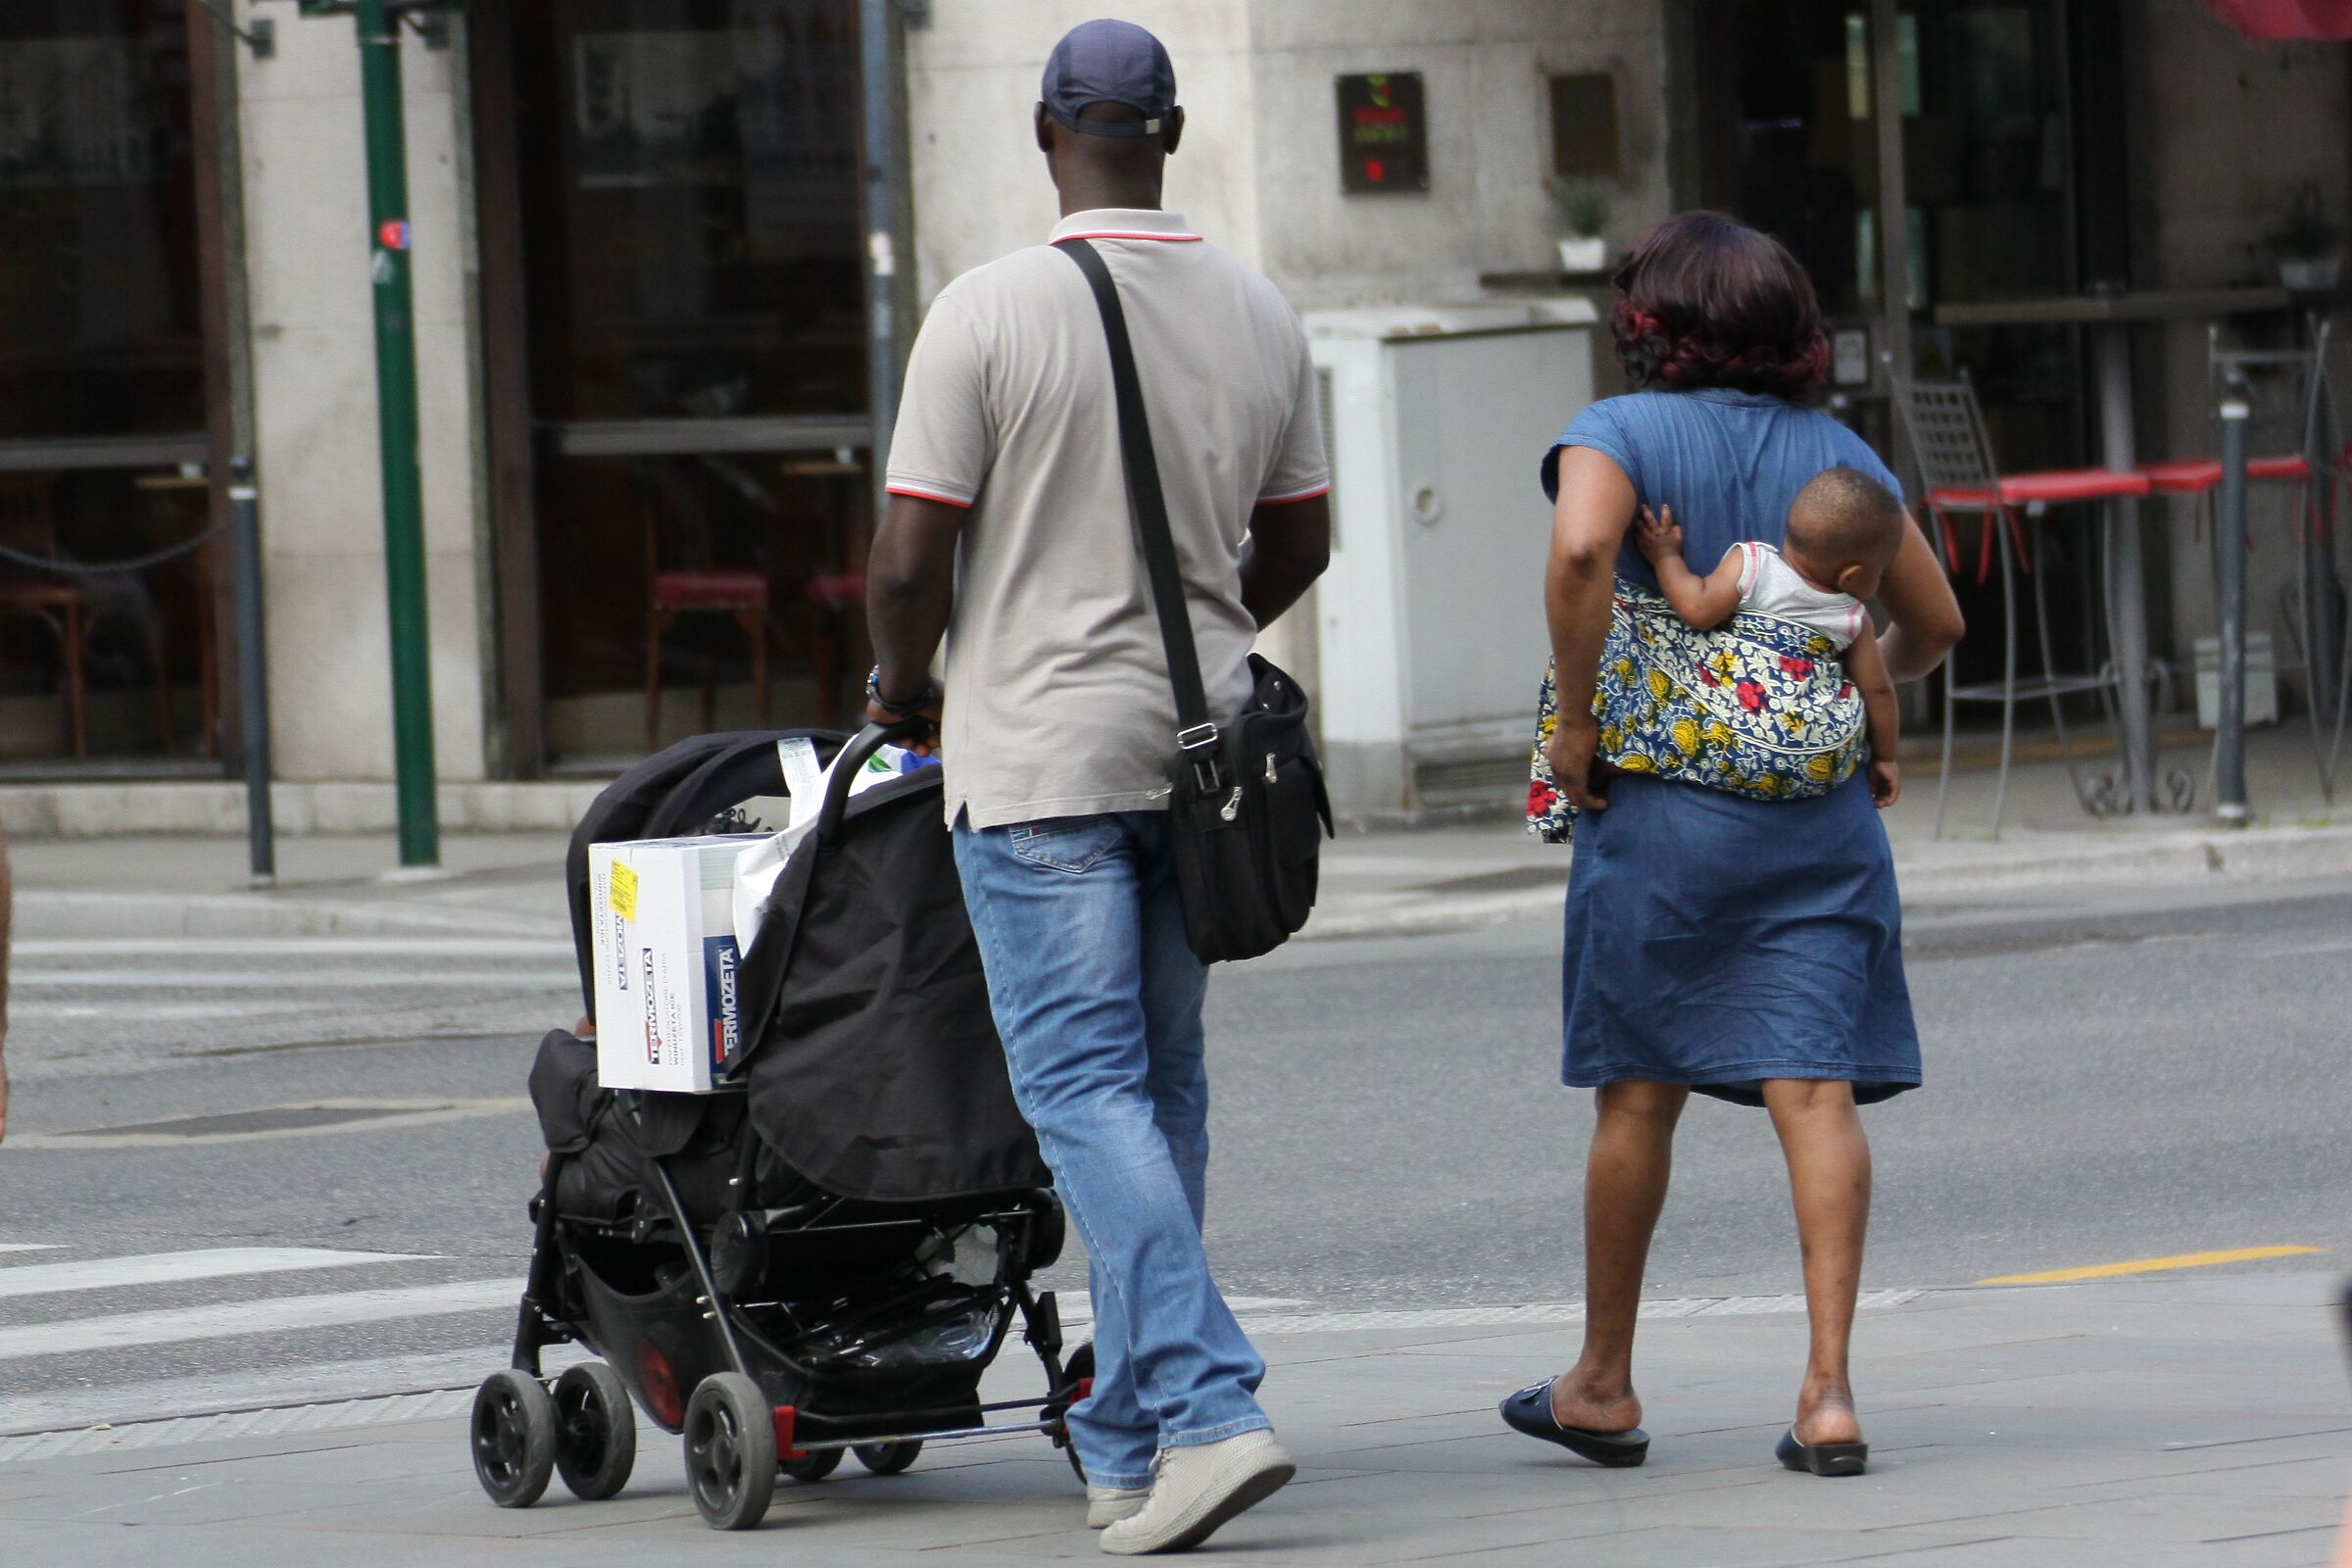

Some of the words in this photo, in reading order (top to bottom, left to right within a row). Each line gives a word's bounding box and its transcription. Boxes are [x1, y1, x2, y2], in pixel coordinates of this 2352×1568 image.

[613, 912, 628, 990] MOZETA
[720, 949, 738, 1056] TERMOZETA
[643, 950, 659, 1061] TERMOZETA
